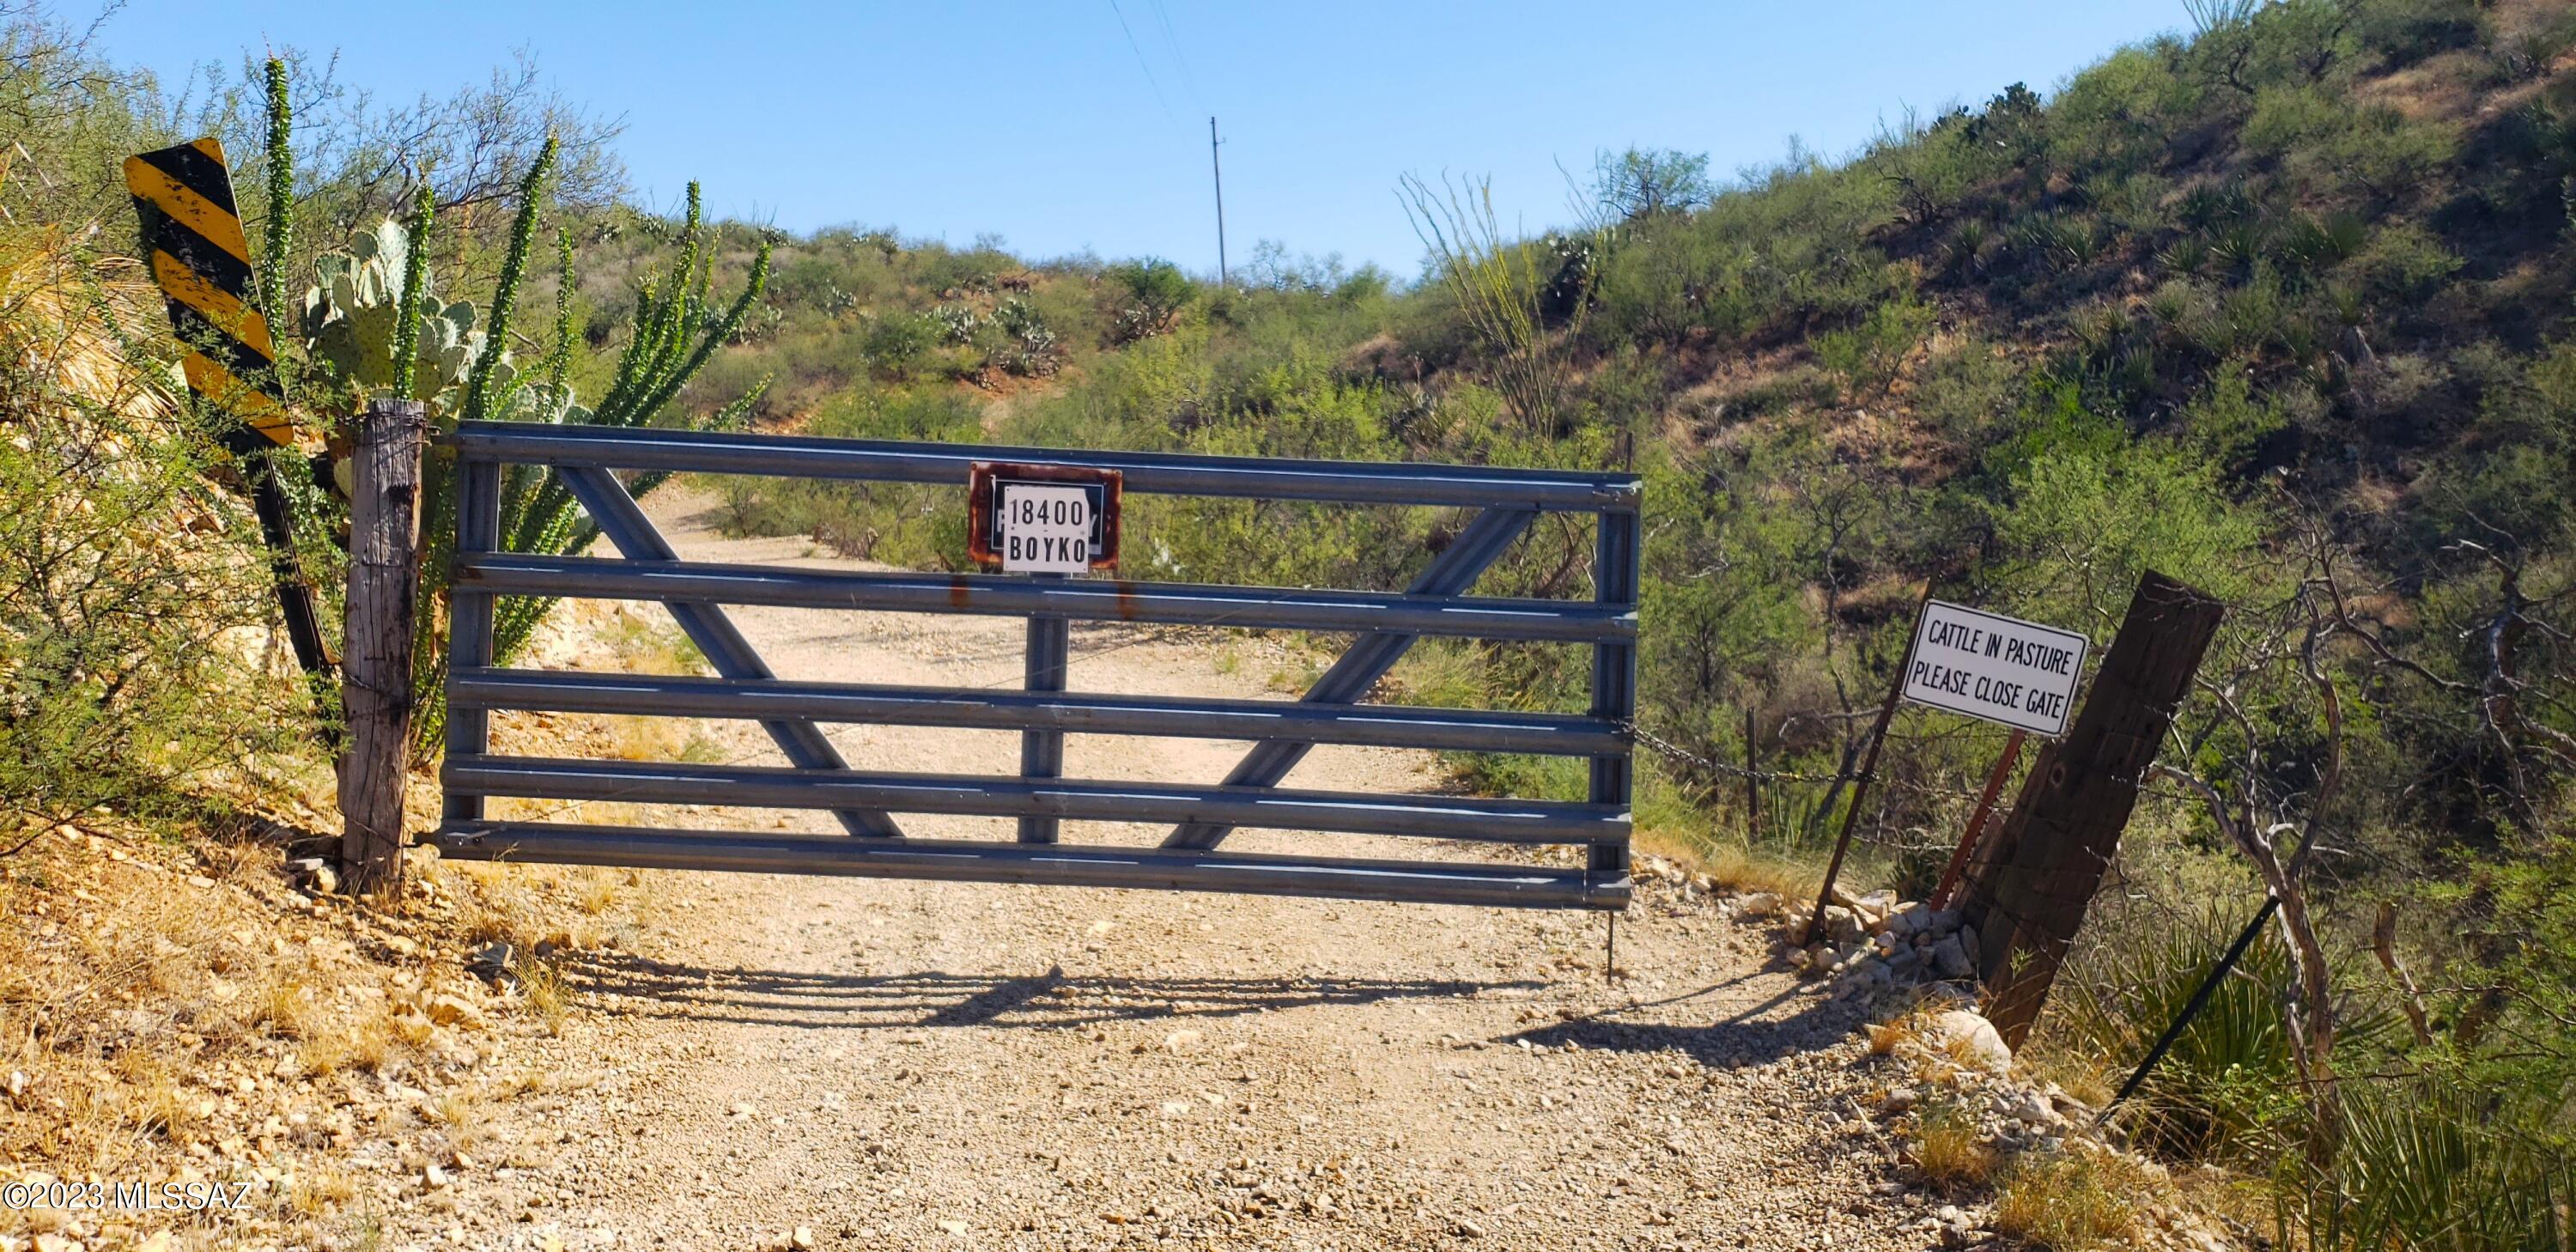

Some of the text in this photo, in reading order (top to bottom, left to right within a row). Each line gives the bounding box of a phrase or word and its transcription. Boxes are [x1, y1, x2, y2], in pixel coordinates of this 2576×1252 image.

[1010, 499, 1083, 526] 18400
[1010, 536, 1085, 562] BOYKO
[1929, 619, 2073, 675] CATTLE IN PASTURE
[1912, 660, 2064, 719] PLEASE CLOSE GATE
